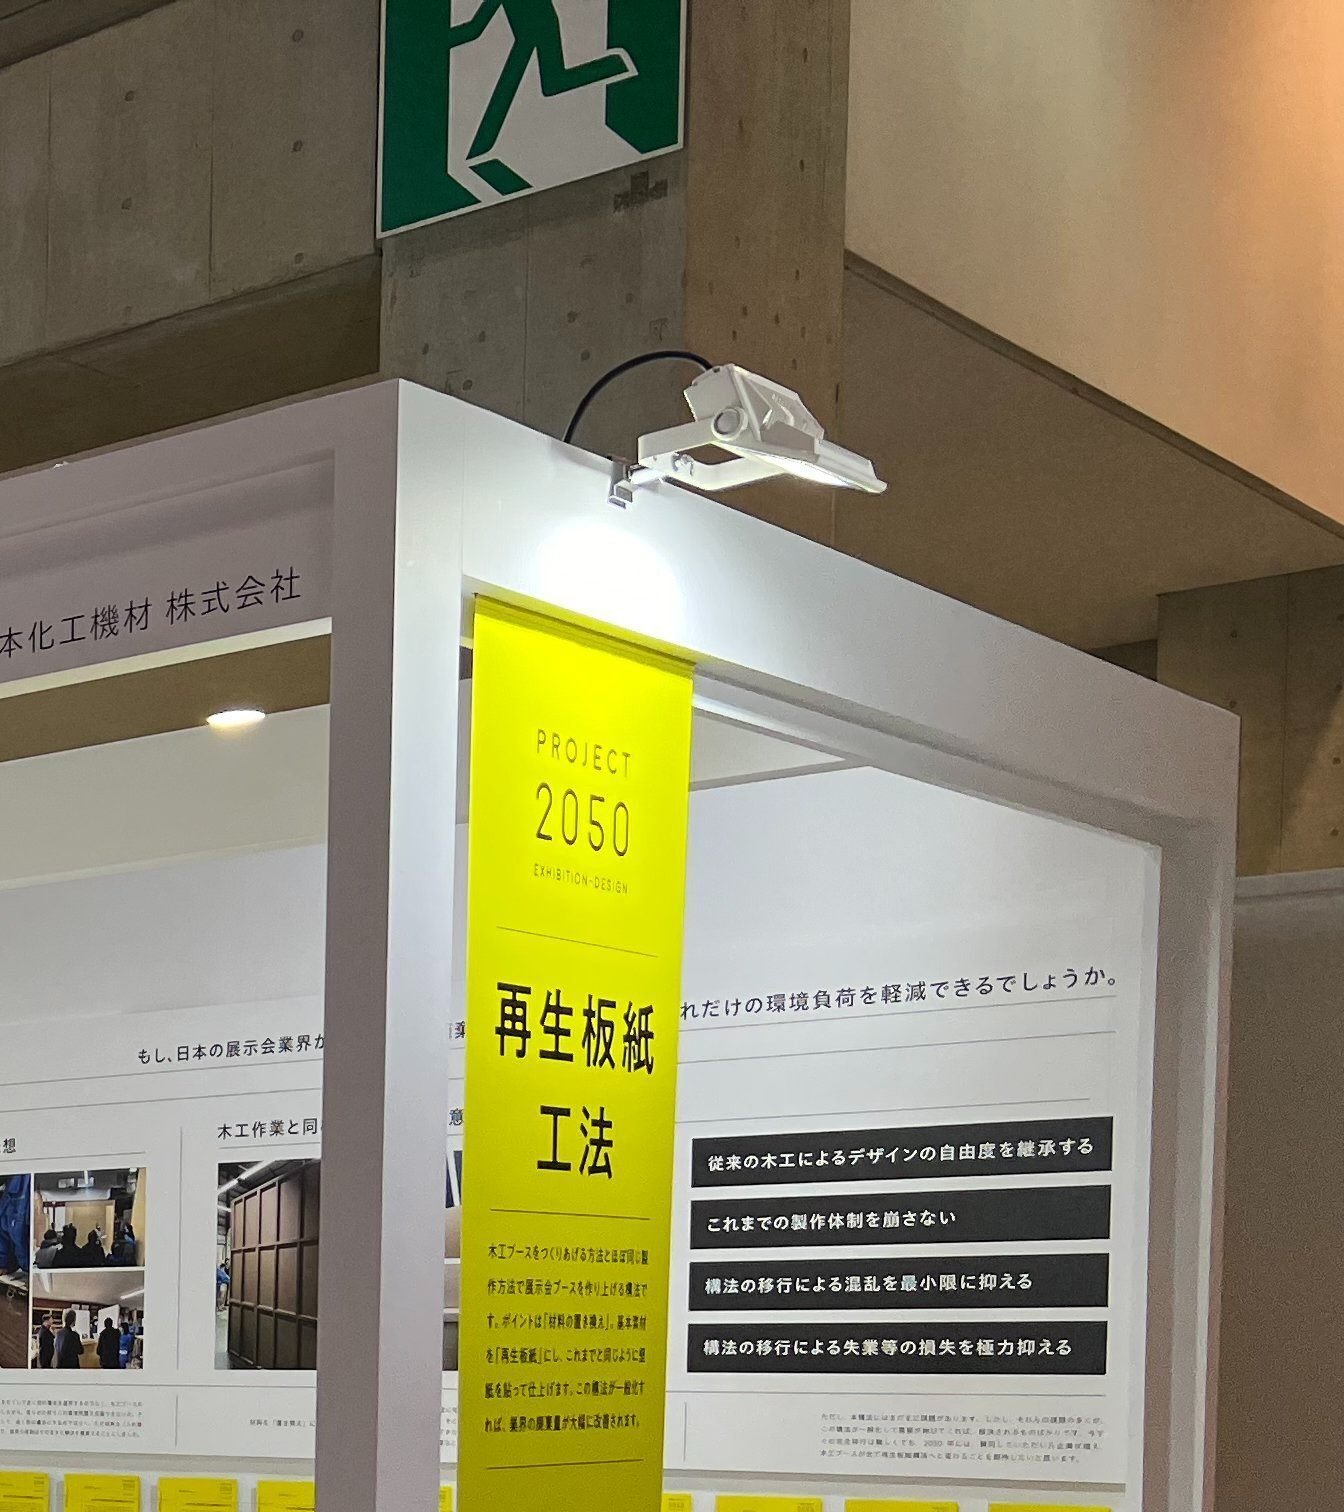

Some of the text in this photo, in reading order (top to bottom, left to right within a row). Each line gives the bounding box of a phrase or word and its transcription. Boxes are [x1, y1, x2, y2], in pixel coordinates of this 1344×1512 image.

[165, 566, 301, 623] 株式会社
[536, 729, 632, 779] PROJECT
[535, 782, 631, 858] 2050
[533, 863, 629, 896] EXHIBITION-DESIGN
[680, 966, 1117, 1021] れだけの環境負荷を軽減できるでしょうか。
[495, 981, 656, 1075] 再生板紙
[217, 1117, 322, 1141] 木工作業と同
[537, 1104, 613, 1180] 工法
[708, 1137, 1094, 1172] 従来の木工によるデザインの自由度を継承する
[706, 1209, 957, 1233] これまでの製作体制を崩さない
[704, 1273, 1033, 1295] 構法の移行による混乱を最小限に抑える
[703, 1338, 1073, 1358] 構法の移行による失業等の損失を極力抑える
